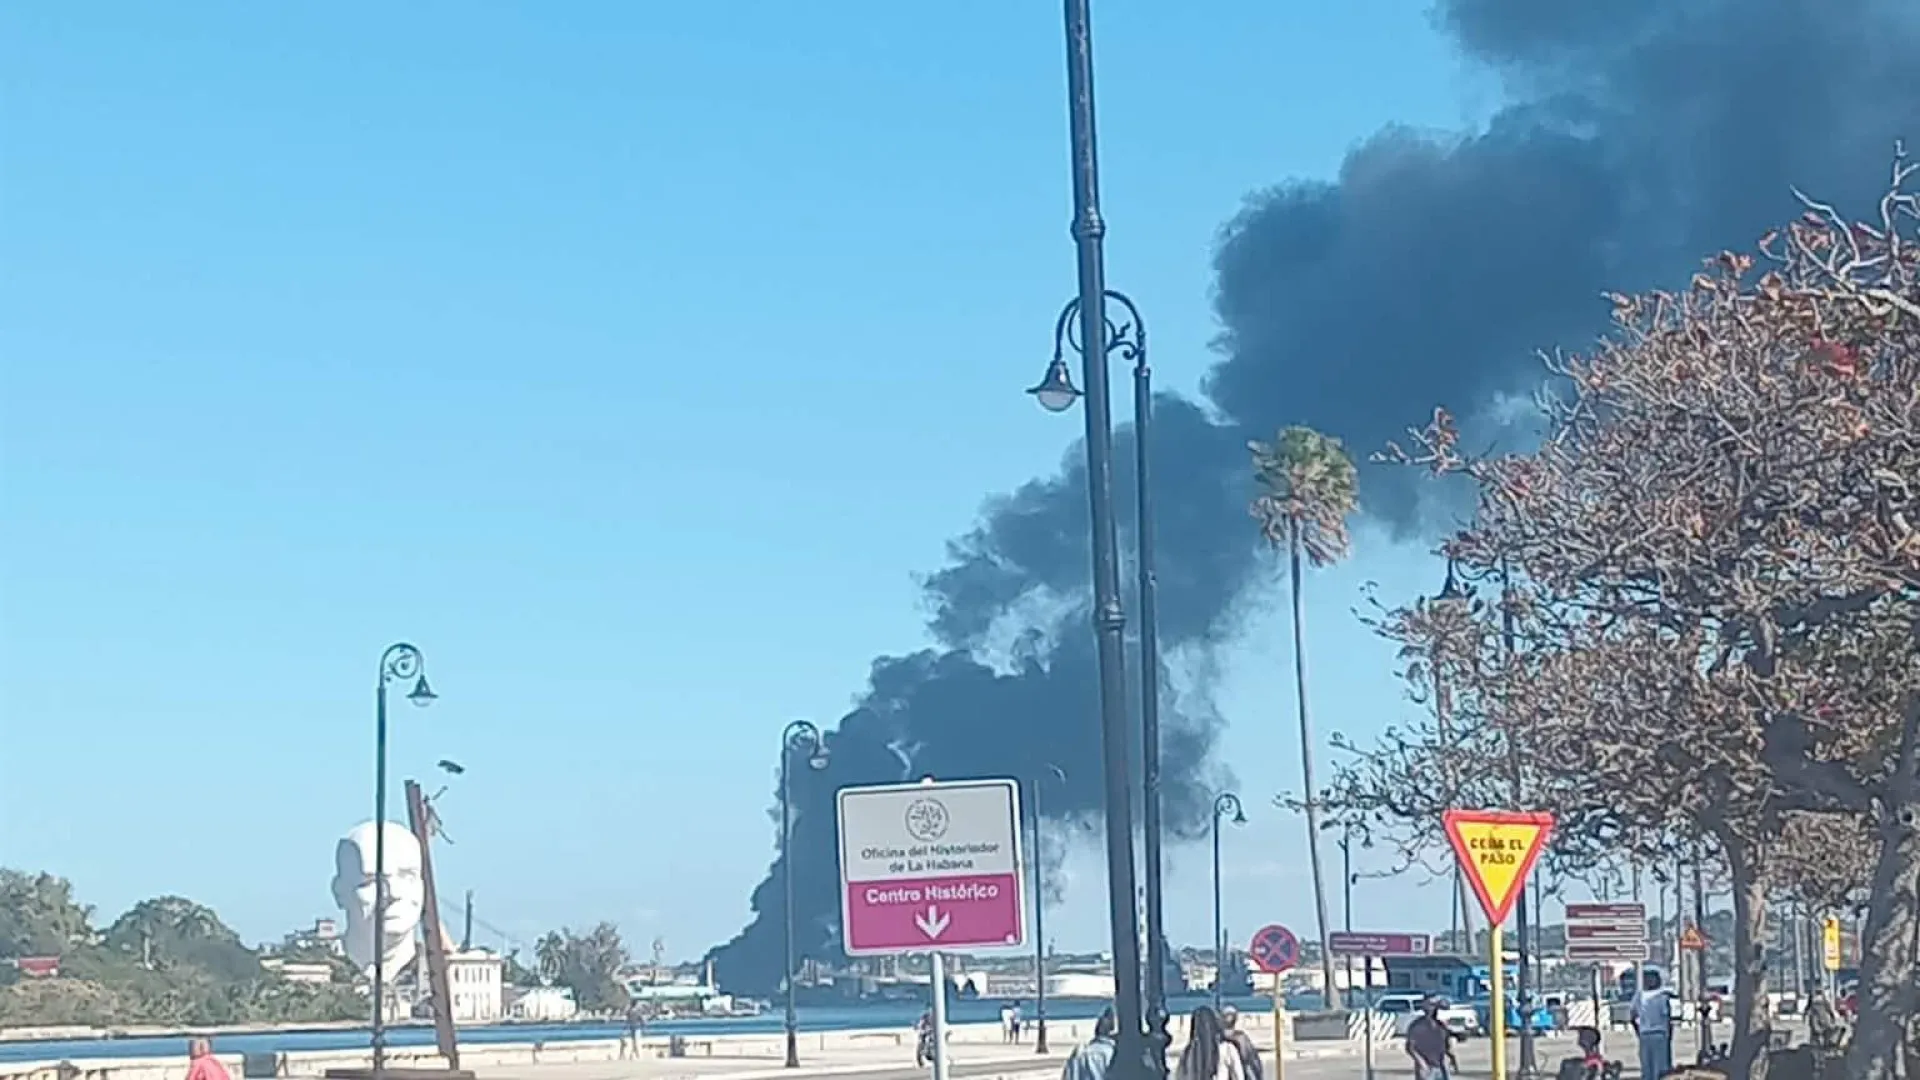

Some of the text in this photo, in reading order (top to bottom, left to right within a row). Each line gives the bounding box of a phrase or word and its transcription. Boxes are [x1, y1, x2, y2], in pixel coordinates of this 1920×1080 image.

[861, 842, 999, 860] Oficina del Historiador
[1509, 839, 1525, 851] EL
[889, 859, 973, 873] de La Habana
[1480, 853, 1516, 865] PASO
[866, 883, 998, 903] Centro Histórico
